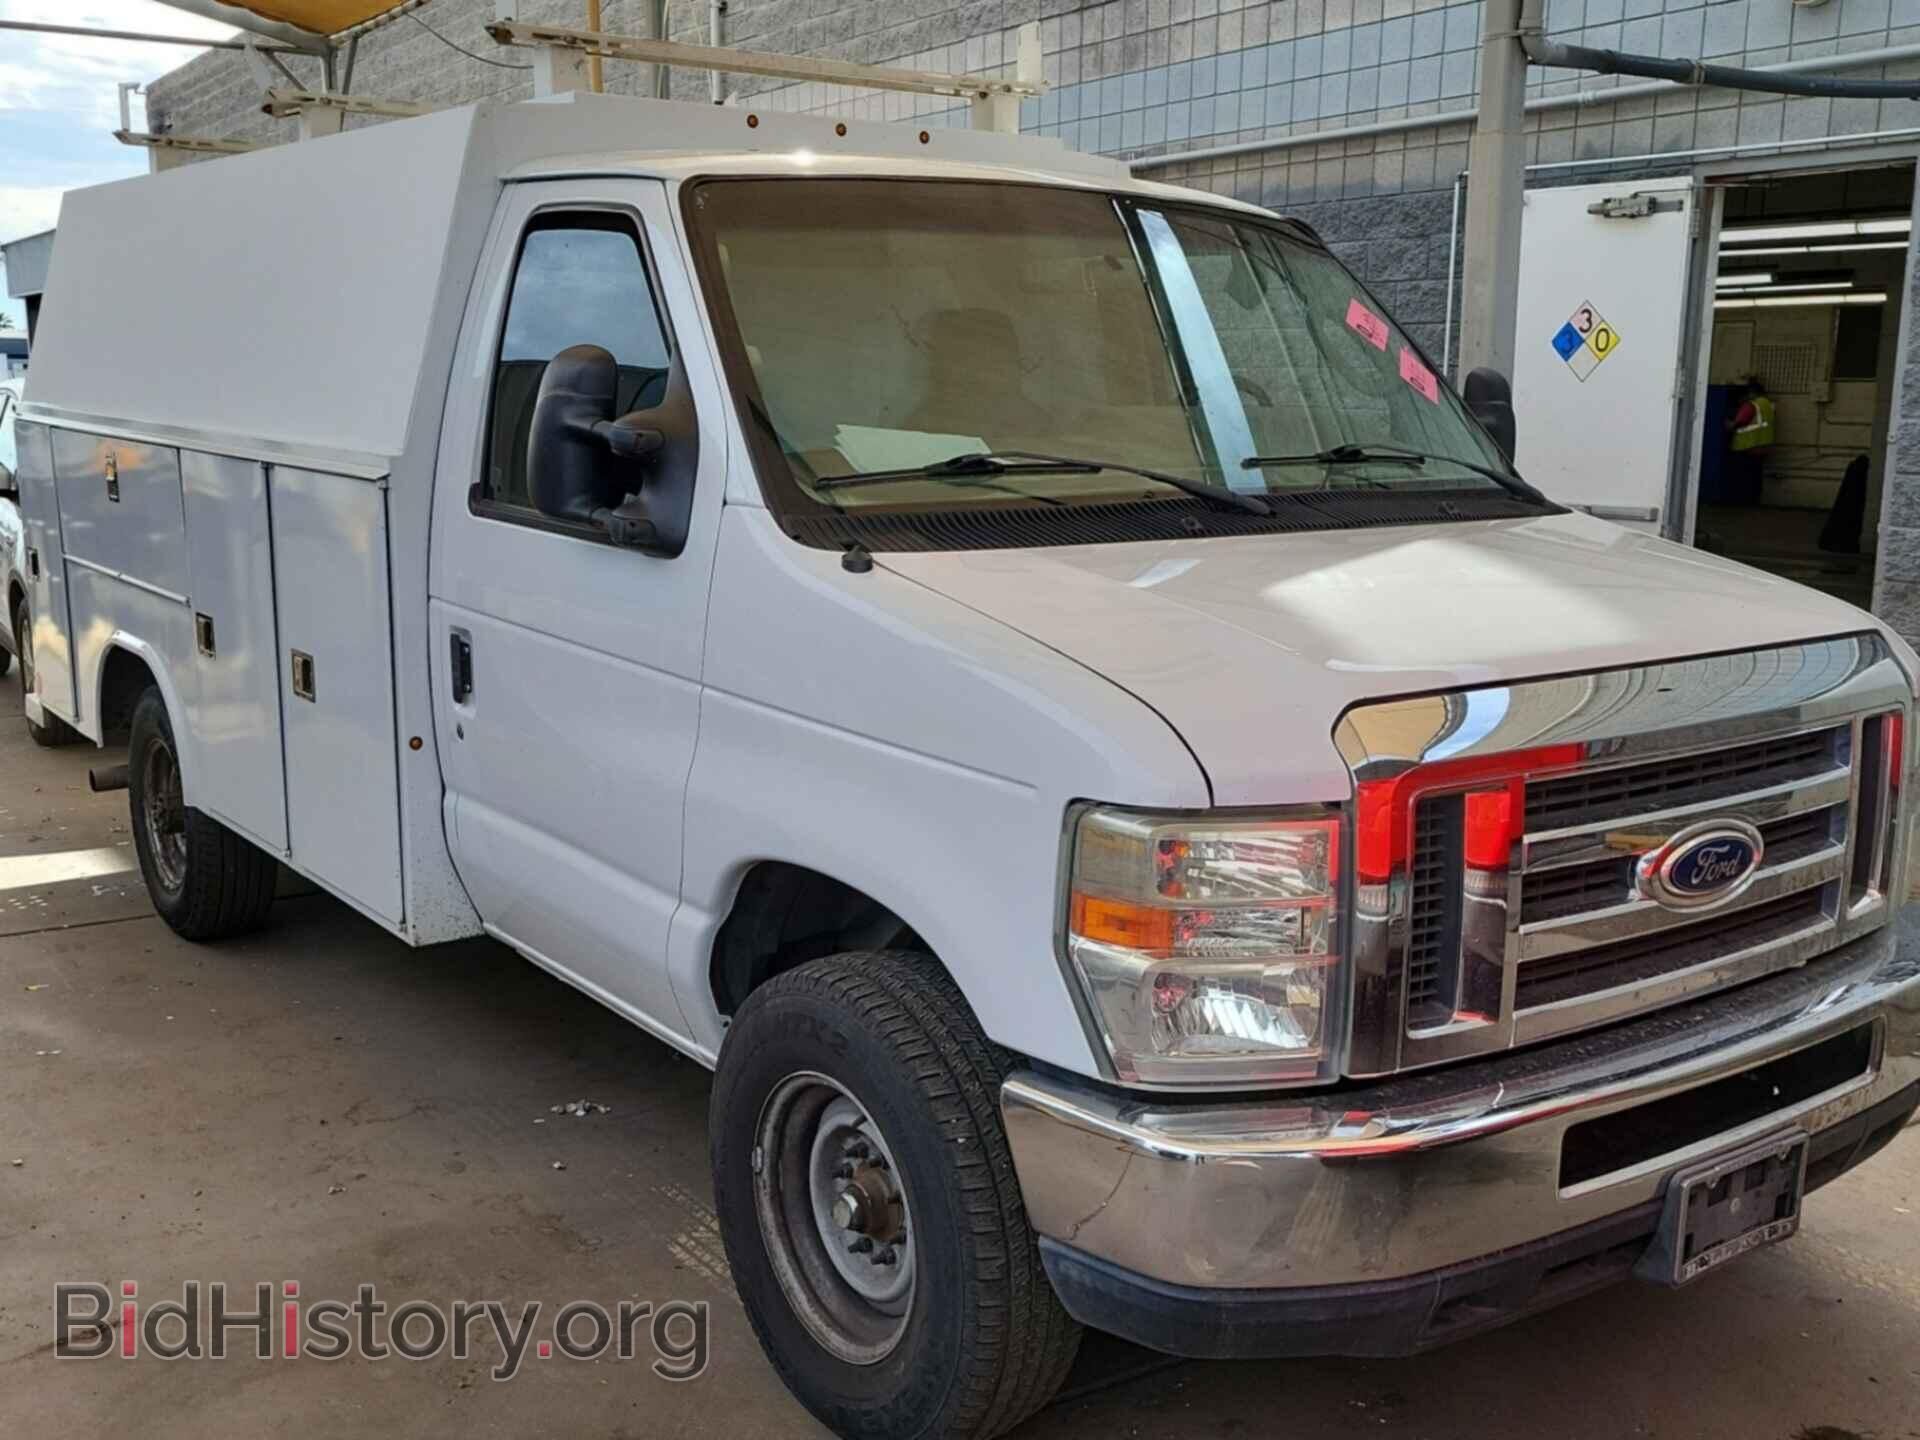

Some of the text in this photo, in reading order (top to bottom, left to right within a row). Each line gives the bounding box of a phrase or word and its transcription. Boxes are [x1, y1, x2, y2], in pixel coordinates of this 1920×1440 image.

[1579, 308, 1592, 333] 3
[1595, 328, 1610, 352] 0
[1691, 844, 1743, 884] Ford
